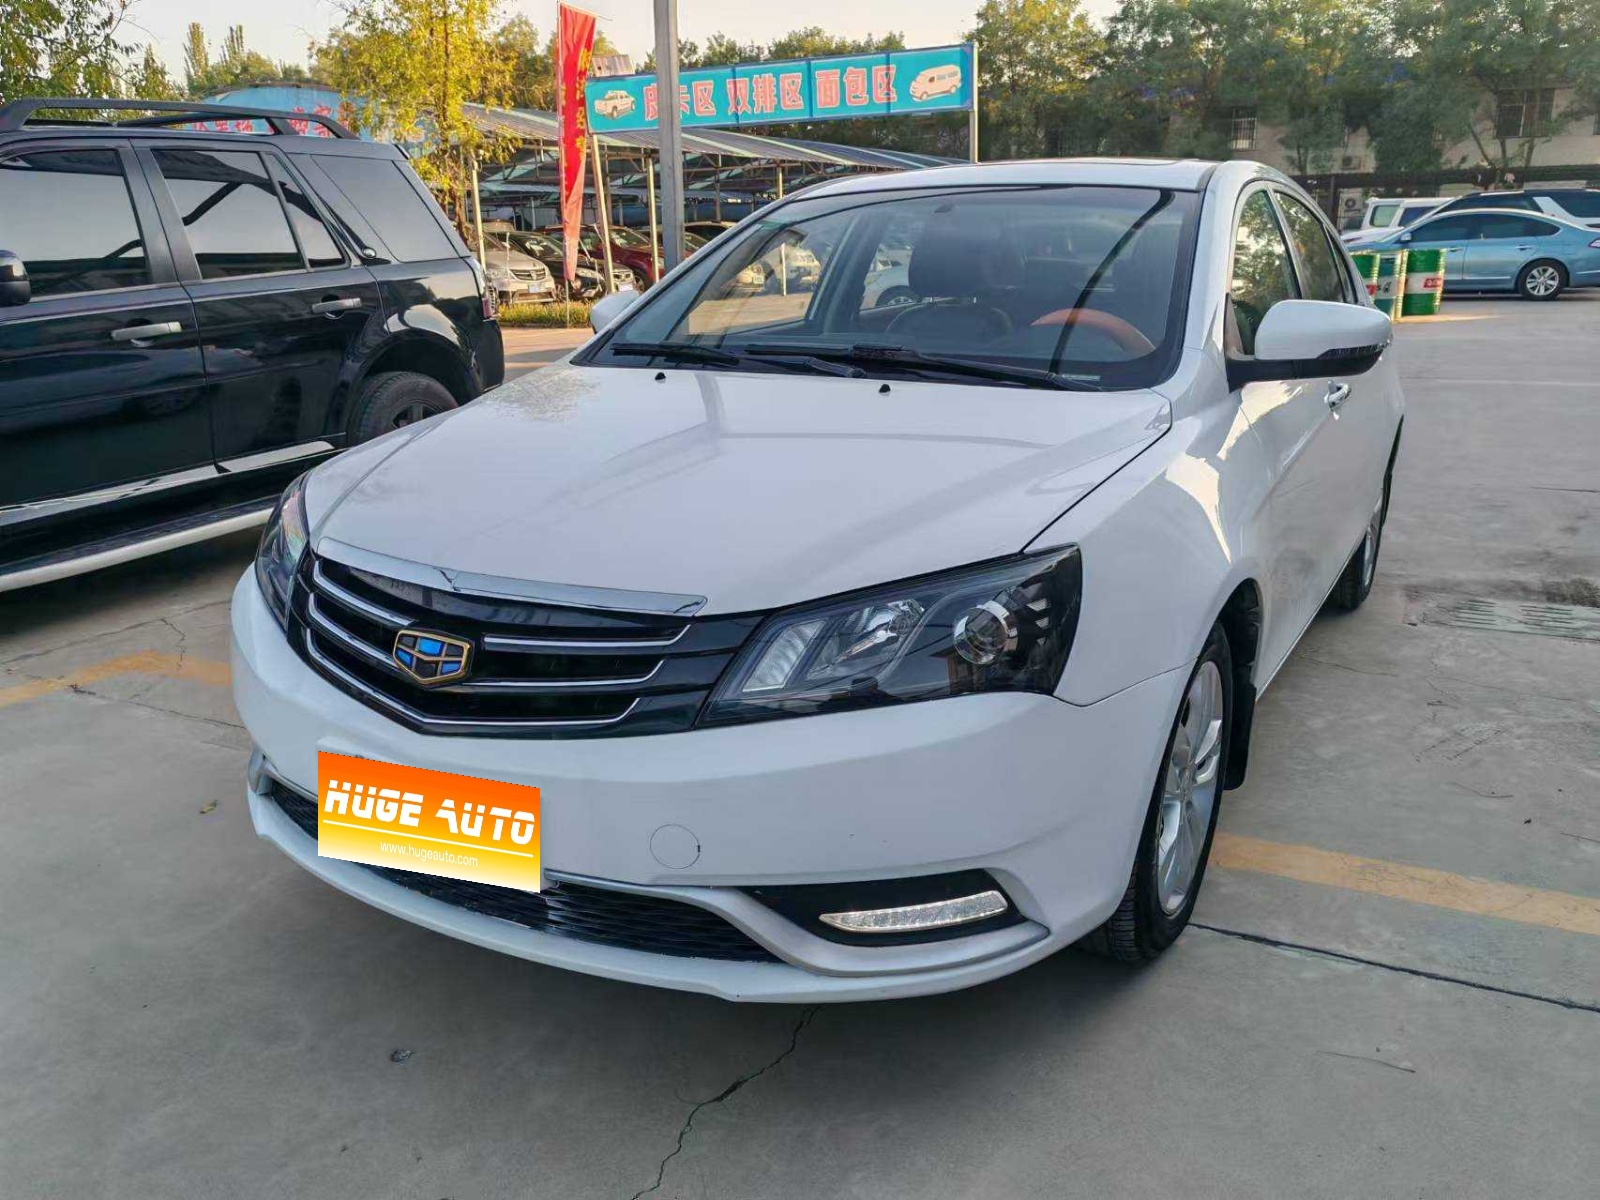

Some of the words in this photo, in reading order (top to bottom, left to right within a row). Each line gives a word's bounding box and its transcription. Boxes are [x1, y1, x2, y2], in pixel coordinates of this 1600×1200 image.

[726, 73, 804, 115] 双排区
[815, 65, 897, 108] 面包区
